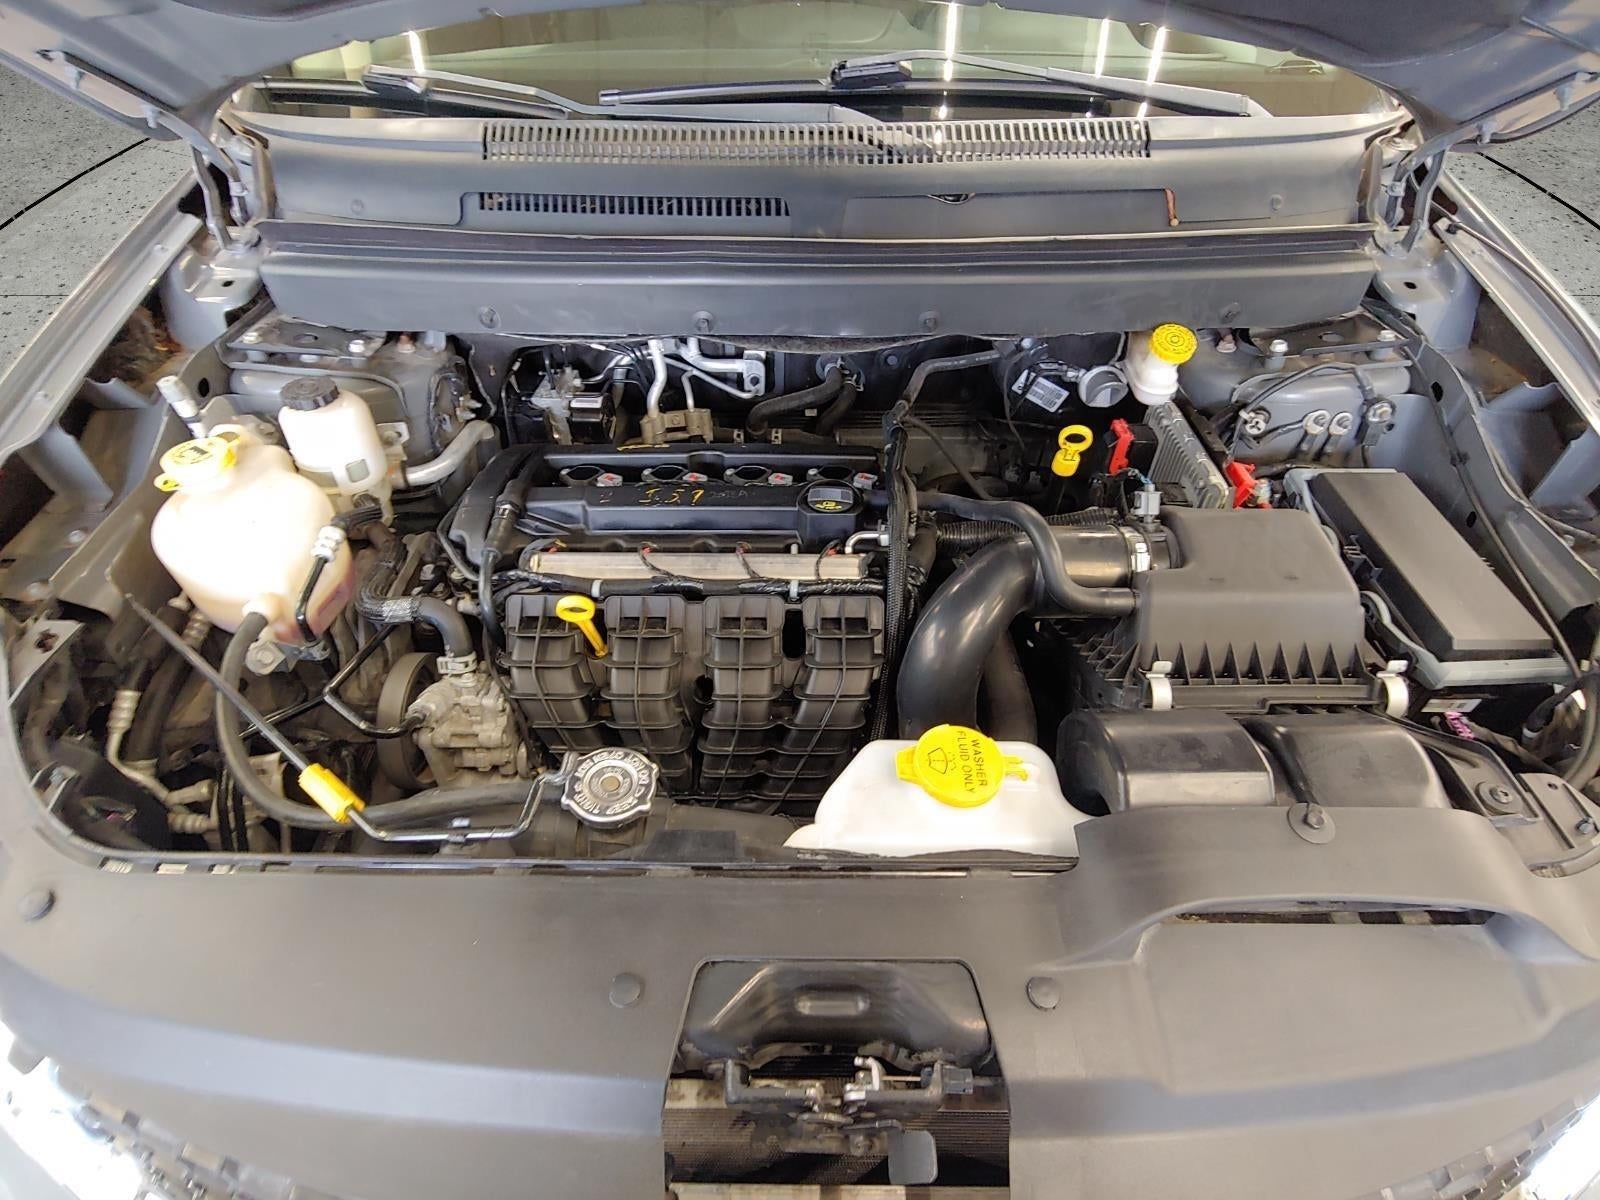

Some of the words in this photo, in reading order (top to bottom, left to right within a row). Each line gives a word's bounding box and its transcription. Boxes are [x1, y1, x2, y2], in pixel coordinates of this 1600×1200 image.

[957, 730, 970, 764] FLUID
[971, 739, 988, 787] WASHER
[962, 764, 975, 793] ONLY
